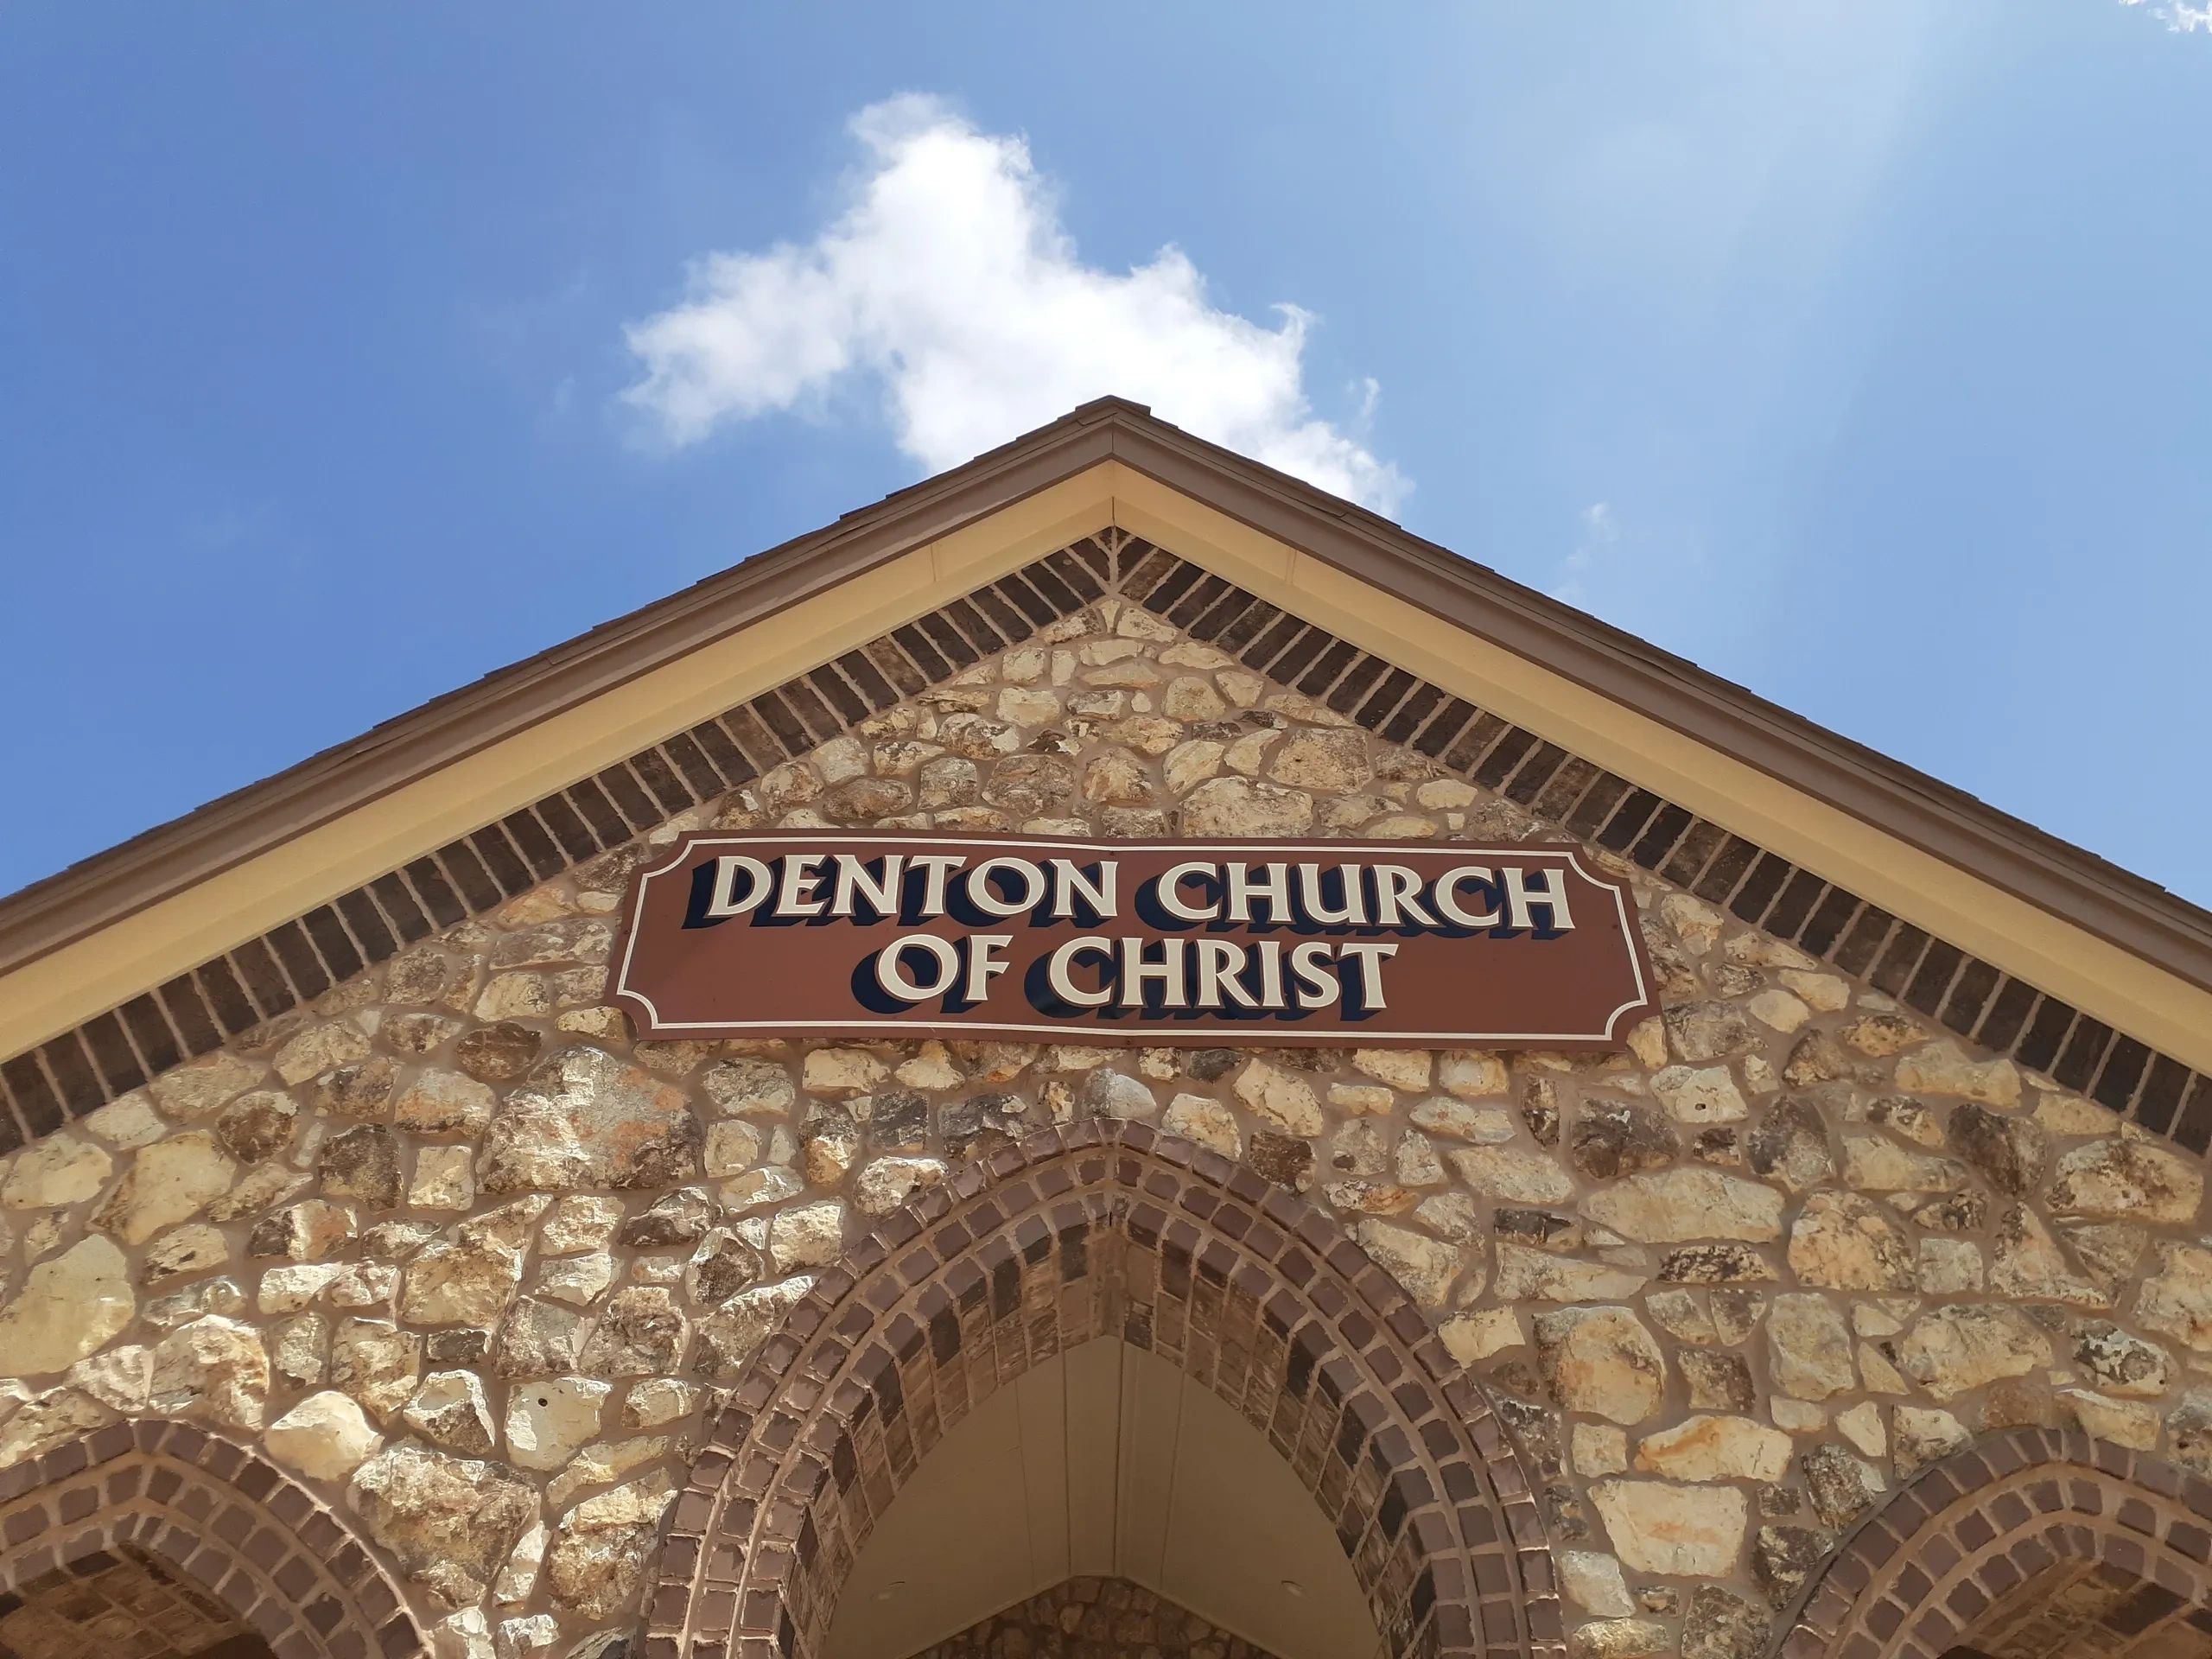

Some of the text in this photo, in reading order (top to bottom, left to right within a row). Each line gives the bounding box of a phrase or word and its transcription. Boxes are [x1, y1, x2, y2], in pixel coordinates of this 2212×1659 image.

[707, 853, 1577, 930] DENTON CHURCH
[877, 932, 1399, 1010] OF CHRIST
